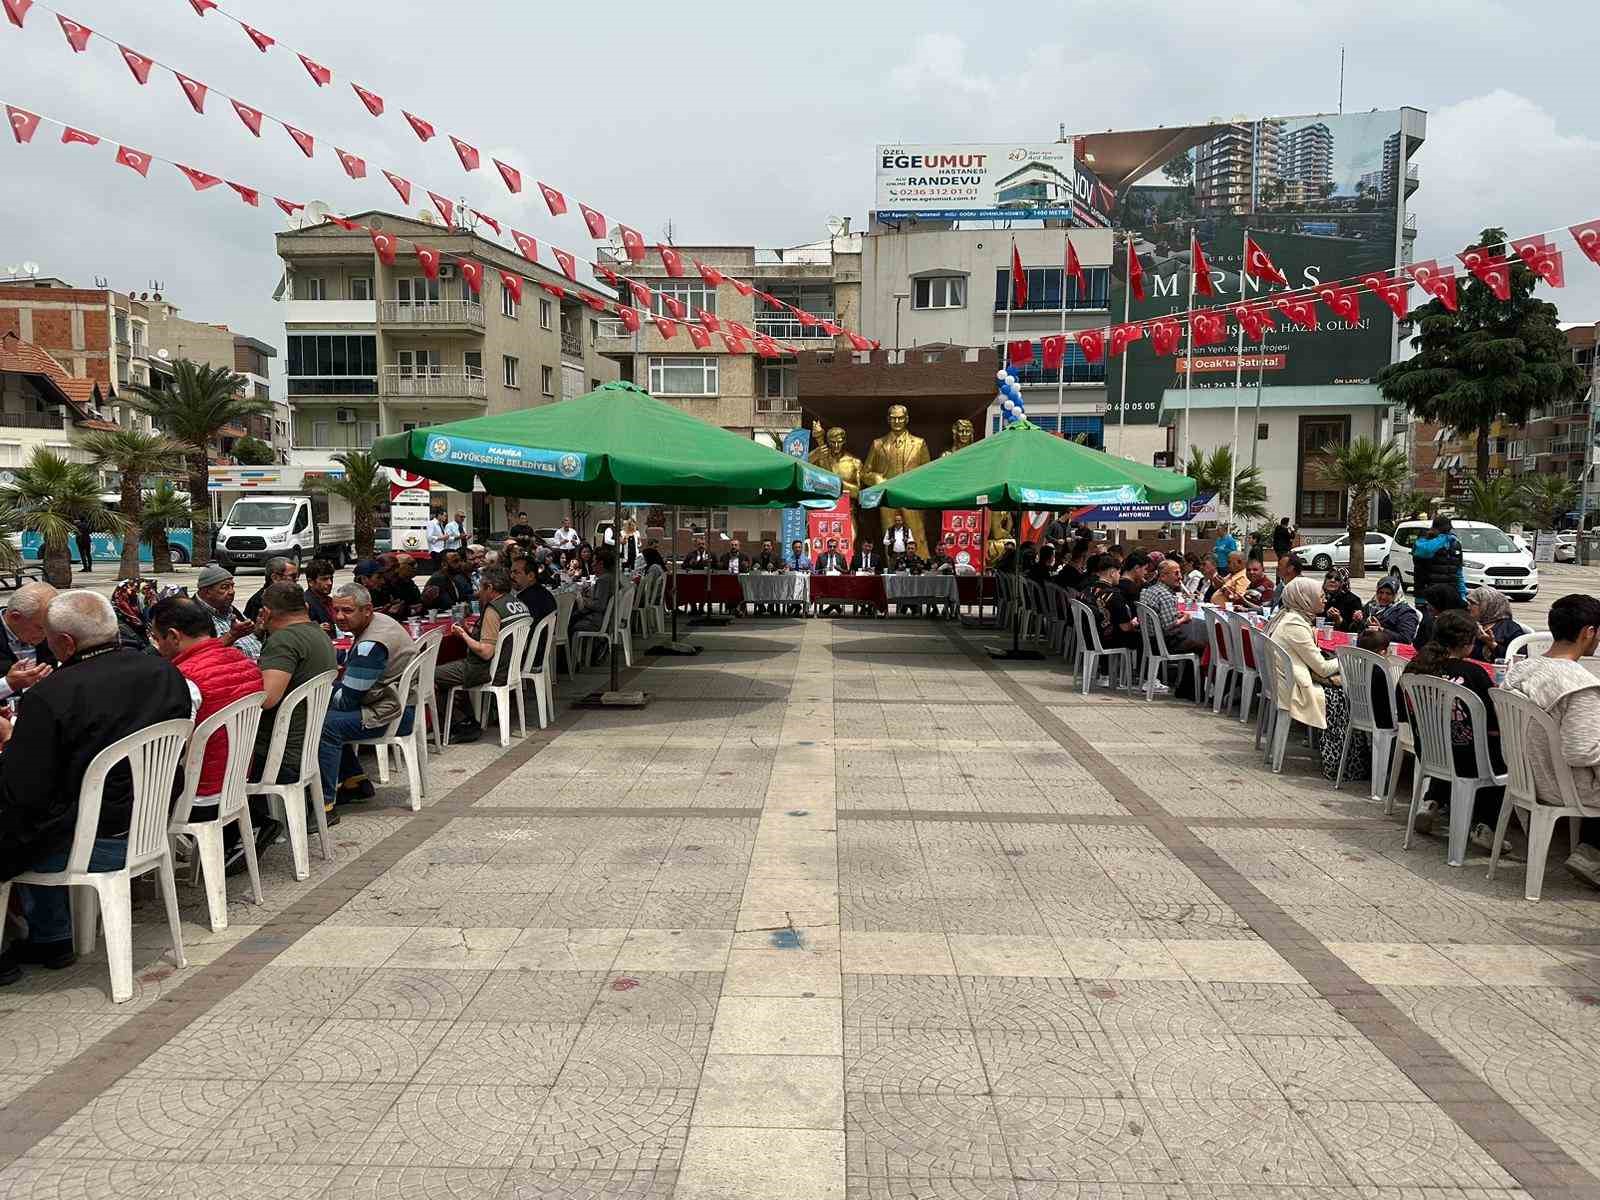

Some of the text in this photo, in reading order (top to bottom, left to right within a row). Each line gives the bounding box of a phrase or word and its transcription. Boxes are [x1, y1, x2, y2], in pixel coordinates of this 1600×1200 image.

[882, 154, 988, 169] EGEUMUT
[908, 176, 981, 186] RANDEVU
[450, 450, 556, 473] BÜYÜKŞEHİR BELEDİYESİ
